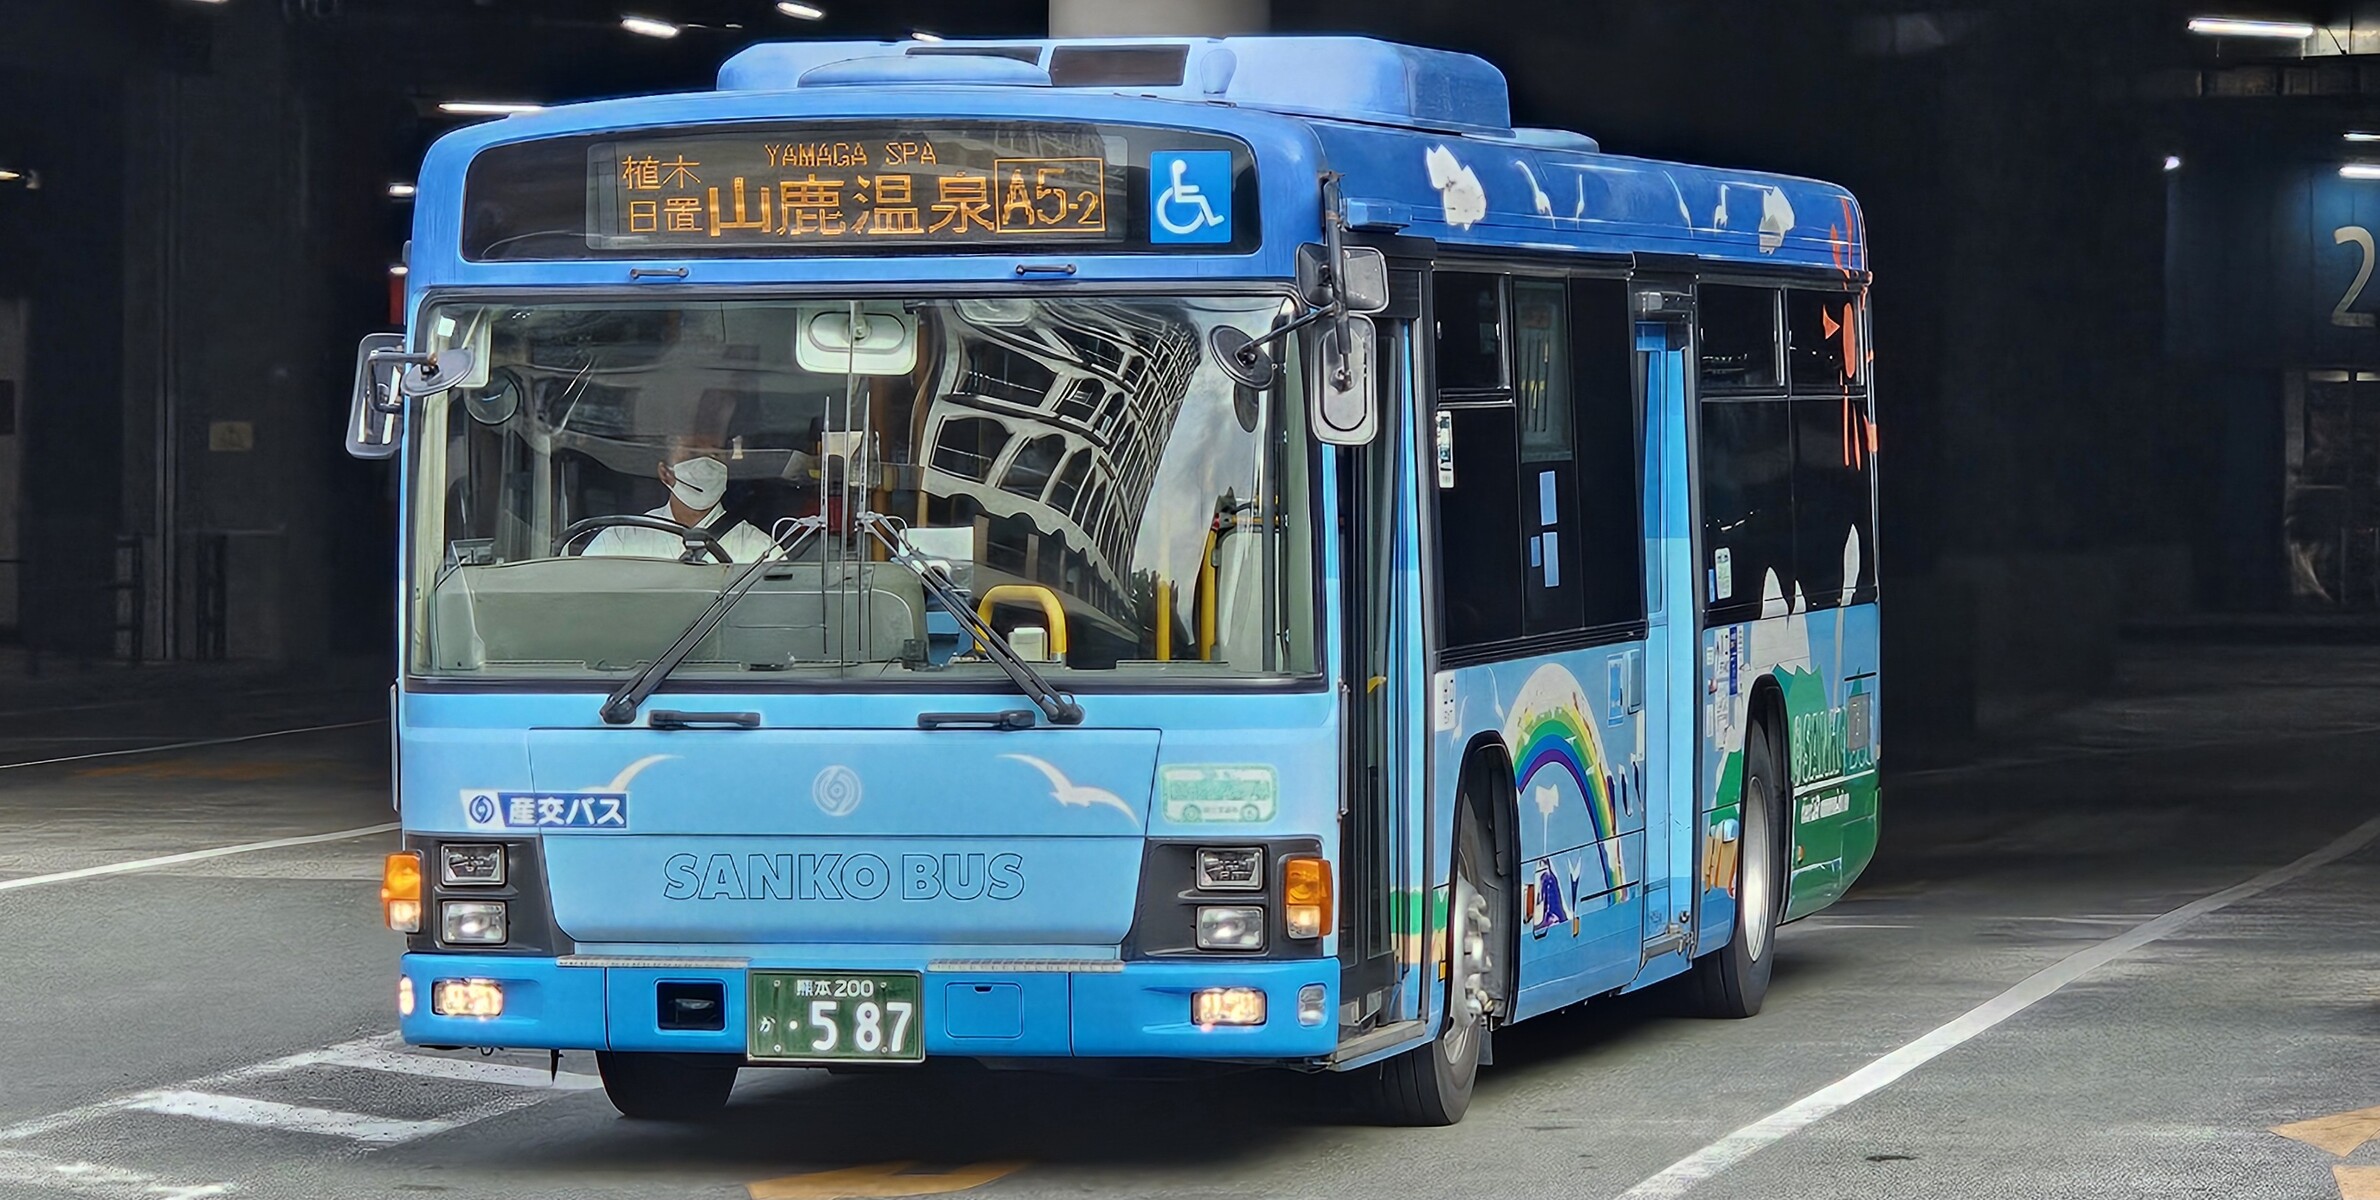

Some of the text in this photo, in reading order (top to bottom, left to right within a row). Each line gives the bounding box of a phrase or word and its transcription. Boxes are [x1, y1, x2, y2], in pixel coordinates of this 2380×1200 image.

[621, 154, 701, 190] 植木
[765, 140, 938, 168] YAMAGA SPA
[630, 197, 703, 232] 日置
[708, 172, 996, 237] 山鹿温泉
[1002, 168, 1101, 226] A5-2
[2331, 225, 2376, 328] 2
[509, 796, 625, 826] 産交バス
[663, 853, 1025, 900] SANKO BUS
